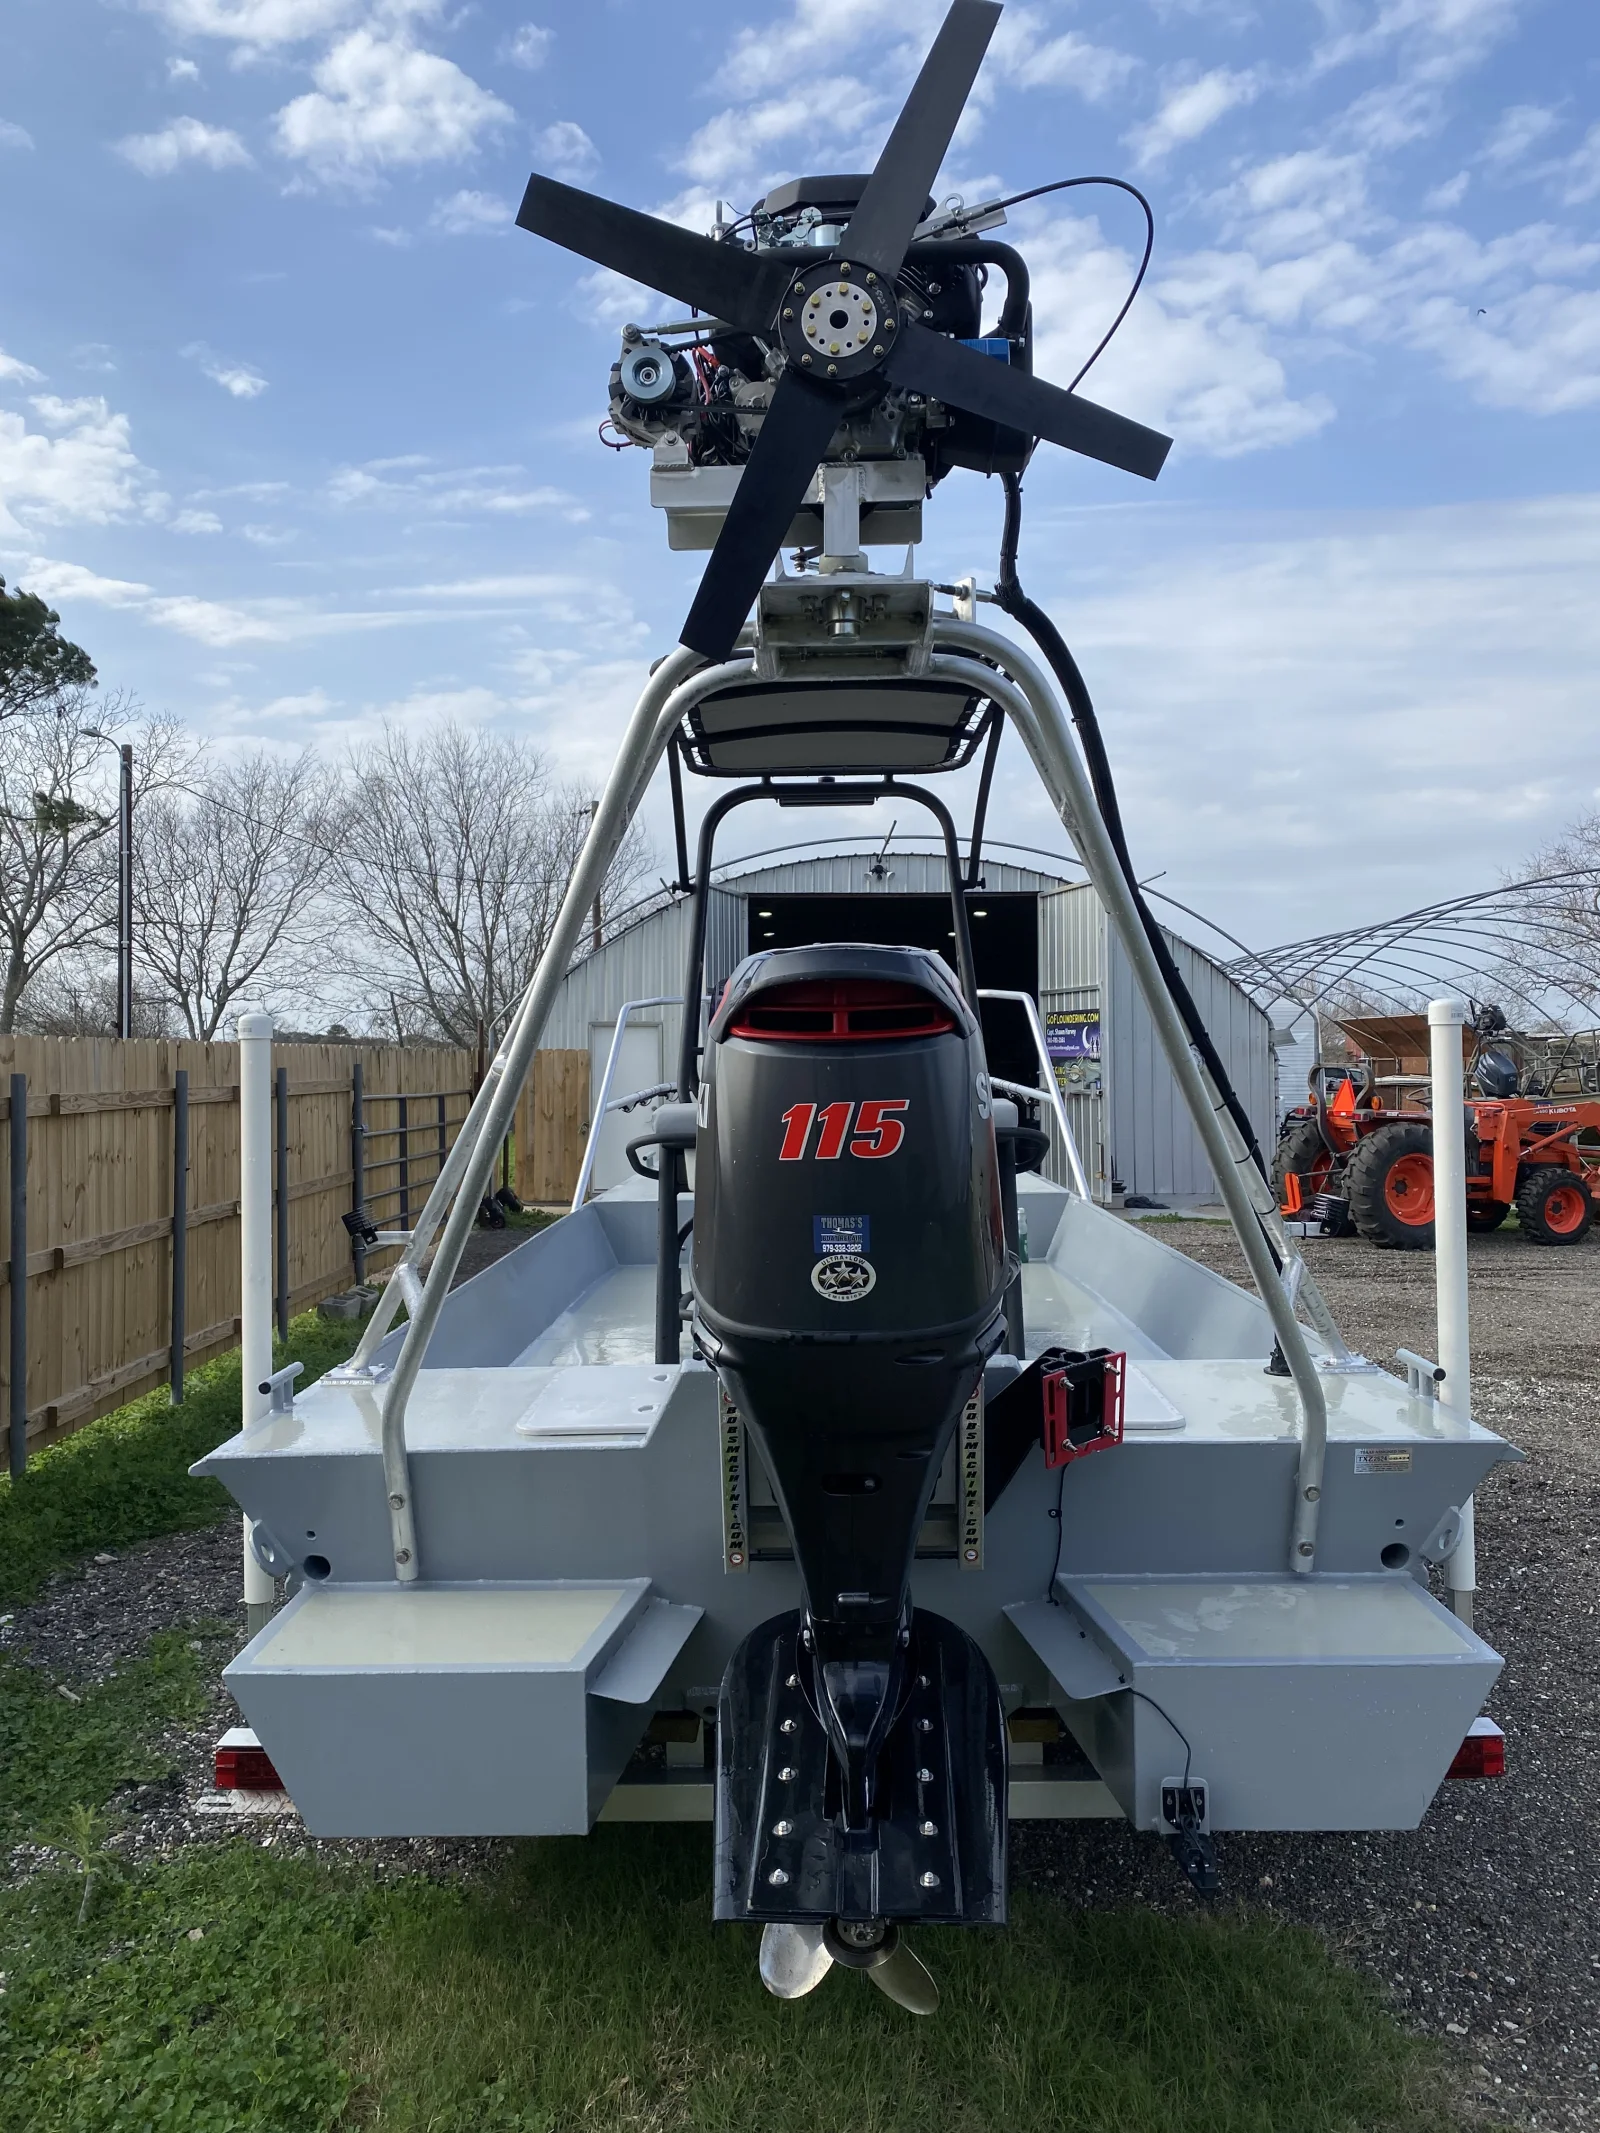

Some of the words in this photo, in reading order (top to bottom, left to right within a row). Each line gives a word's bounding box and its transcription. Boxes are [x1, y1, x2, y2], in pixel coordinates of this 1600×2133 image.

[1549, 1107, 1577, 1115] KUBOTA
[779, 1099, 910, 1160] 115
[821, 1217, 863, 1229] THOMAS'S
[821, 1255, 845, 1266] ULTRA
[849, 1255, 866, 1265] LOW
